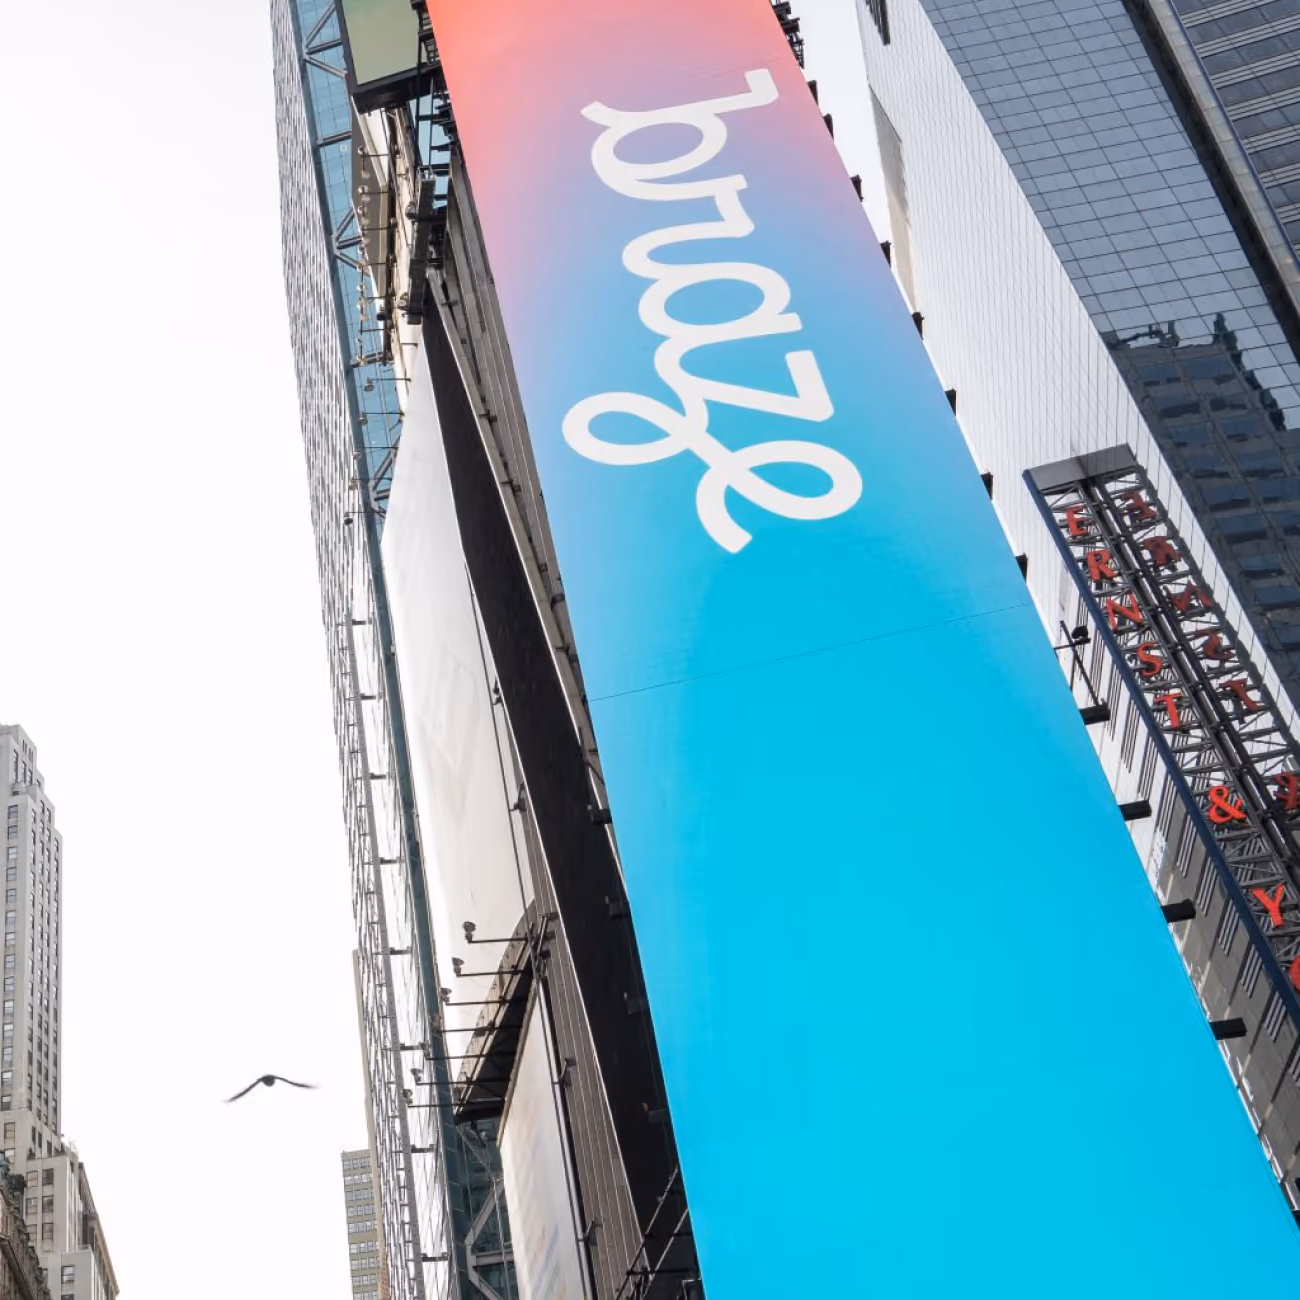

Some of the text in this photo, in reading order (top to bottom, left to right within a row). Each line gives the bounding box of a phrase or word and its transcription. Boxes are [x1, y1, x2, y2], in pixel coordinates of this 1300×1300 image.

[562, 68, 863, 553] braze
[1066, 505, 1184, 730] ERNST
[1208, 785, 1247, 824] &
